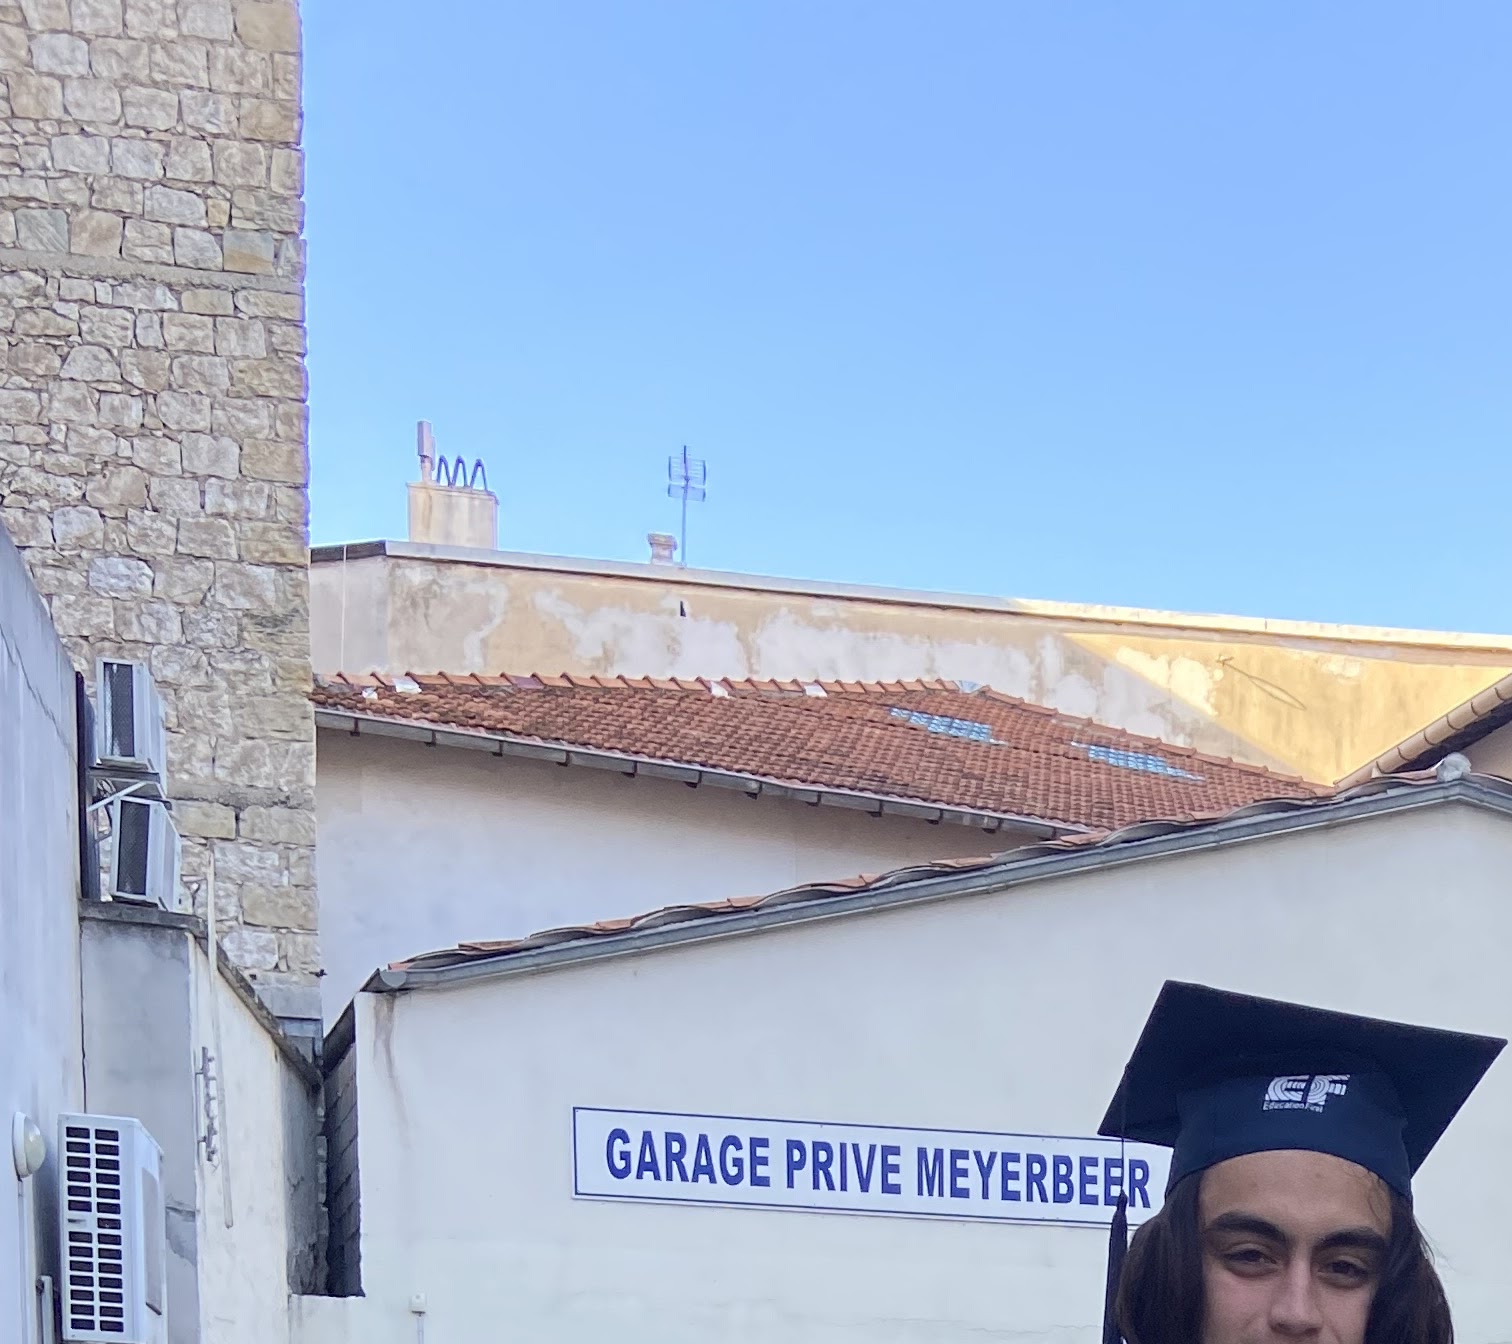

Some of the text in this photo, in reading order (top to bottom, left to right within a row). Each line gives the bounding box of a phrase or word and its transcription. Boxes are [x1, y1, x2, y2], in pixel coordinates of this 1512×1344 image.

[604, 1127, 1152, 1210] GARAGE PRIVE MEYERBEER
